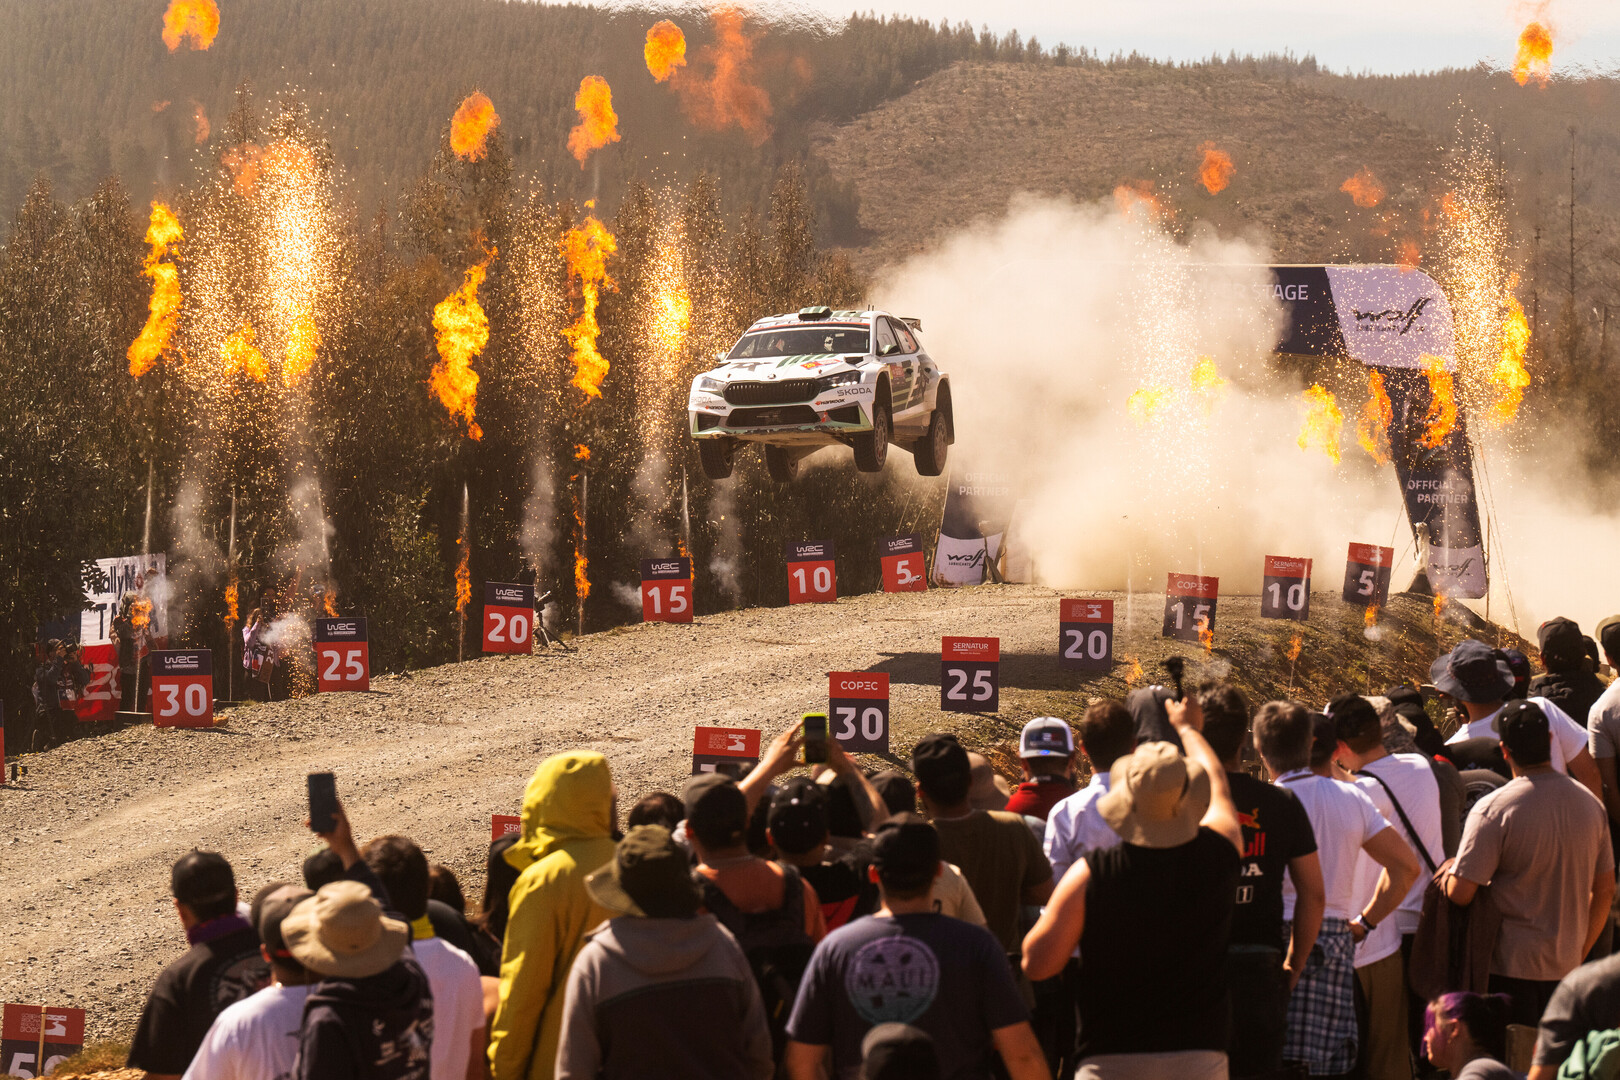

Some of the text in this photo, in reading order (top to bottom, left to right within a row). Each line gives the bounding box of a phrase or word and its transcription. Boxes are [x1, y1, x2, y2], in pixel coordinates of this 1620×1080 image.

[959, 485, 1009, 496] PARTNER
[1407, 480, 1455, 490] OFFICIAL
[1417, 494, 1468, 504] PARTNER
[797, 545, 824, 553] WRC
[888, 537, 912, 547] WRC
[651, 562, 680, 570] WRC
[895, 560, 912, 584] 5
[793, 566, 831, 593] 10
[1356, 570, 1375, 595] 5
[495, 588, 524, 597] WRC
[647, 586, 687, 614] 15
[1267, 582, 1304, 611] 10
[327, 623, 356, 631] WRC
[487, 612, 528, 644] 20
[1170, 602, 1210, 632] 15
[953, 642, 989, 650] SERNATUR
[1064, 629, 1107, 659] 20
[164, 655, 198, 664] WRC
[322, 649, 364, 681] 25
[840, 680, 879, 691] COPEC
[946, 668, 993, 701] 25
[159, 683, 207, 716] 30
[835, 706, 884, 741] 30
